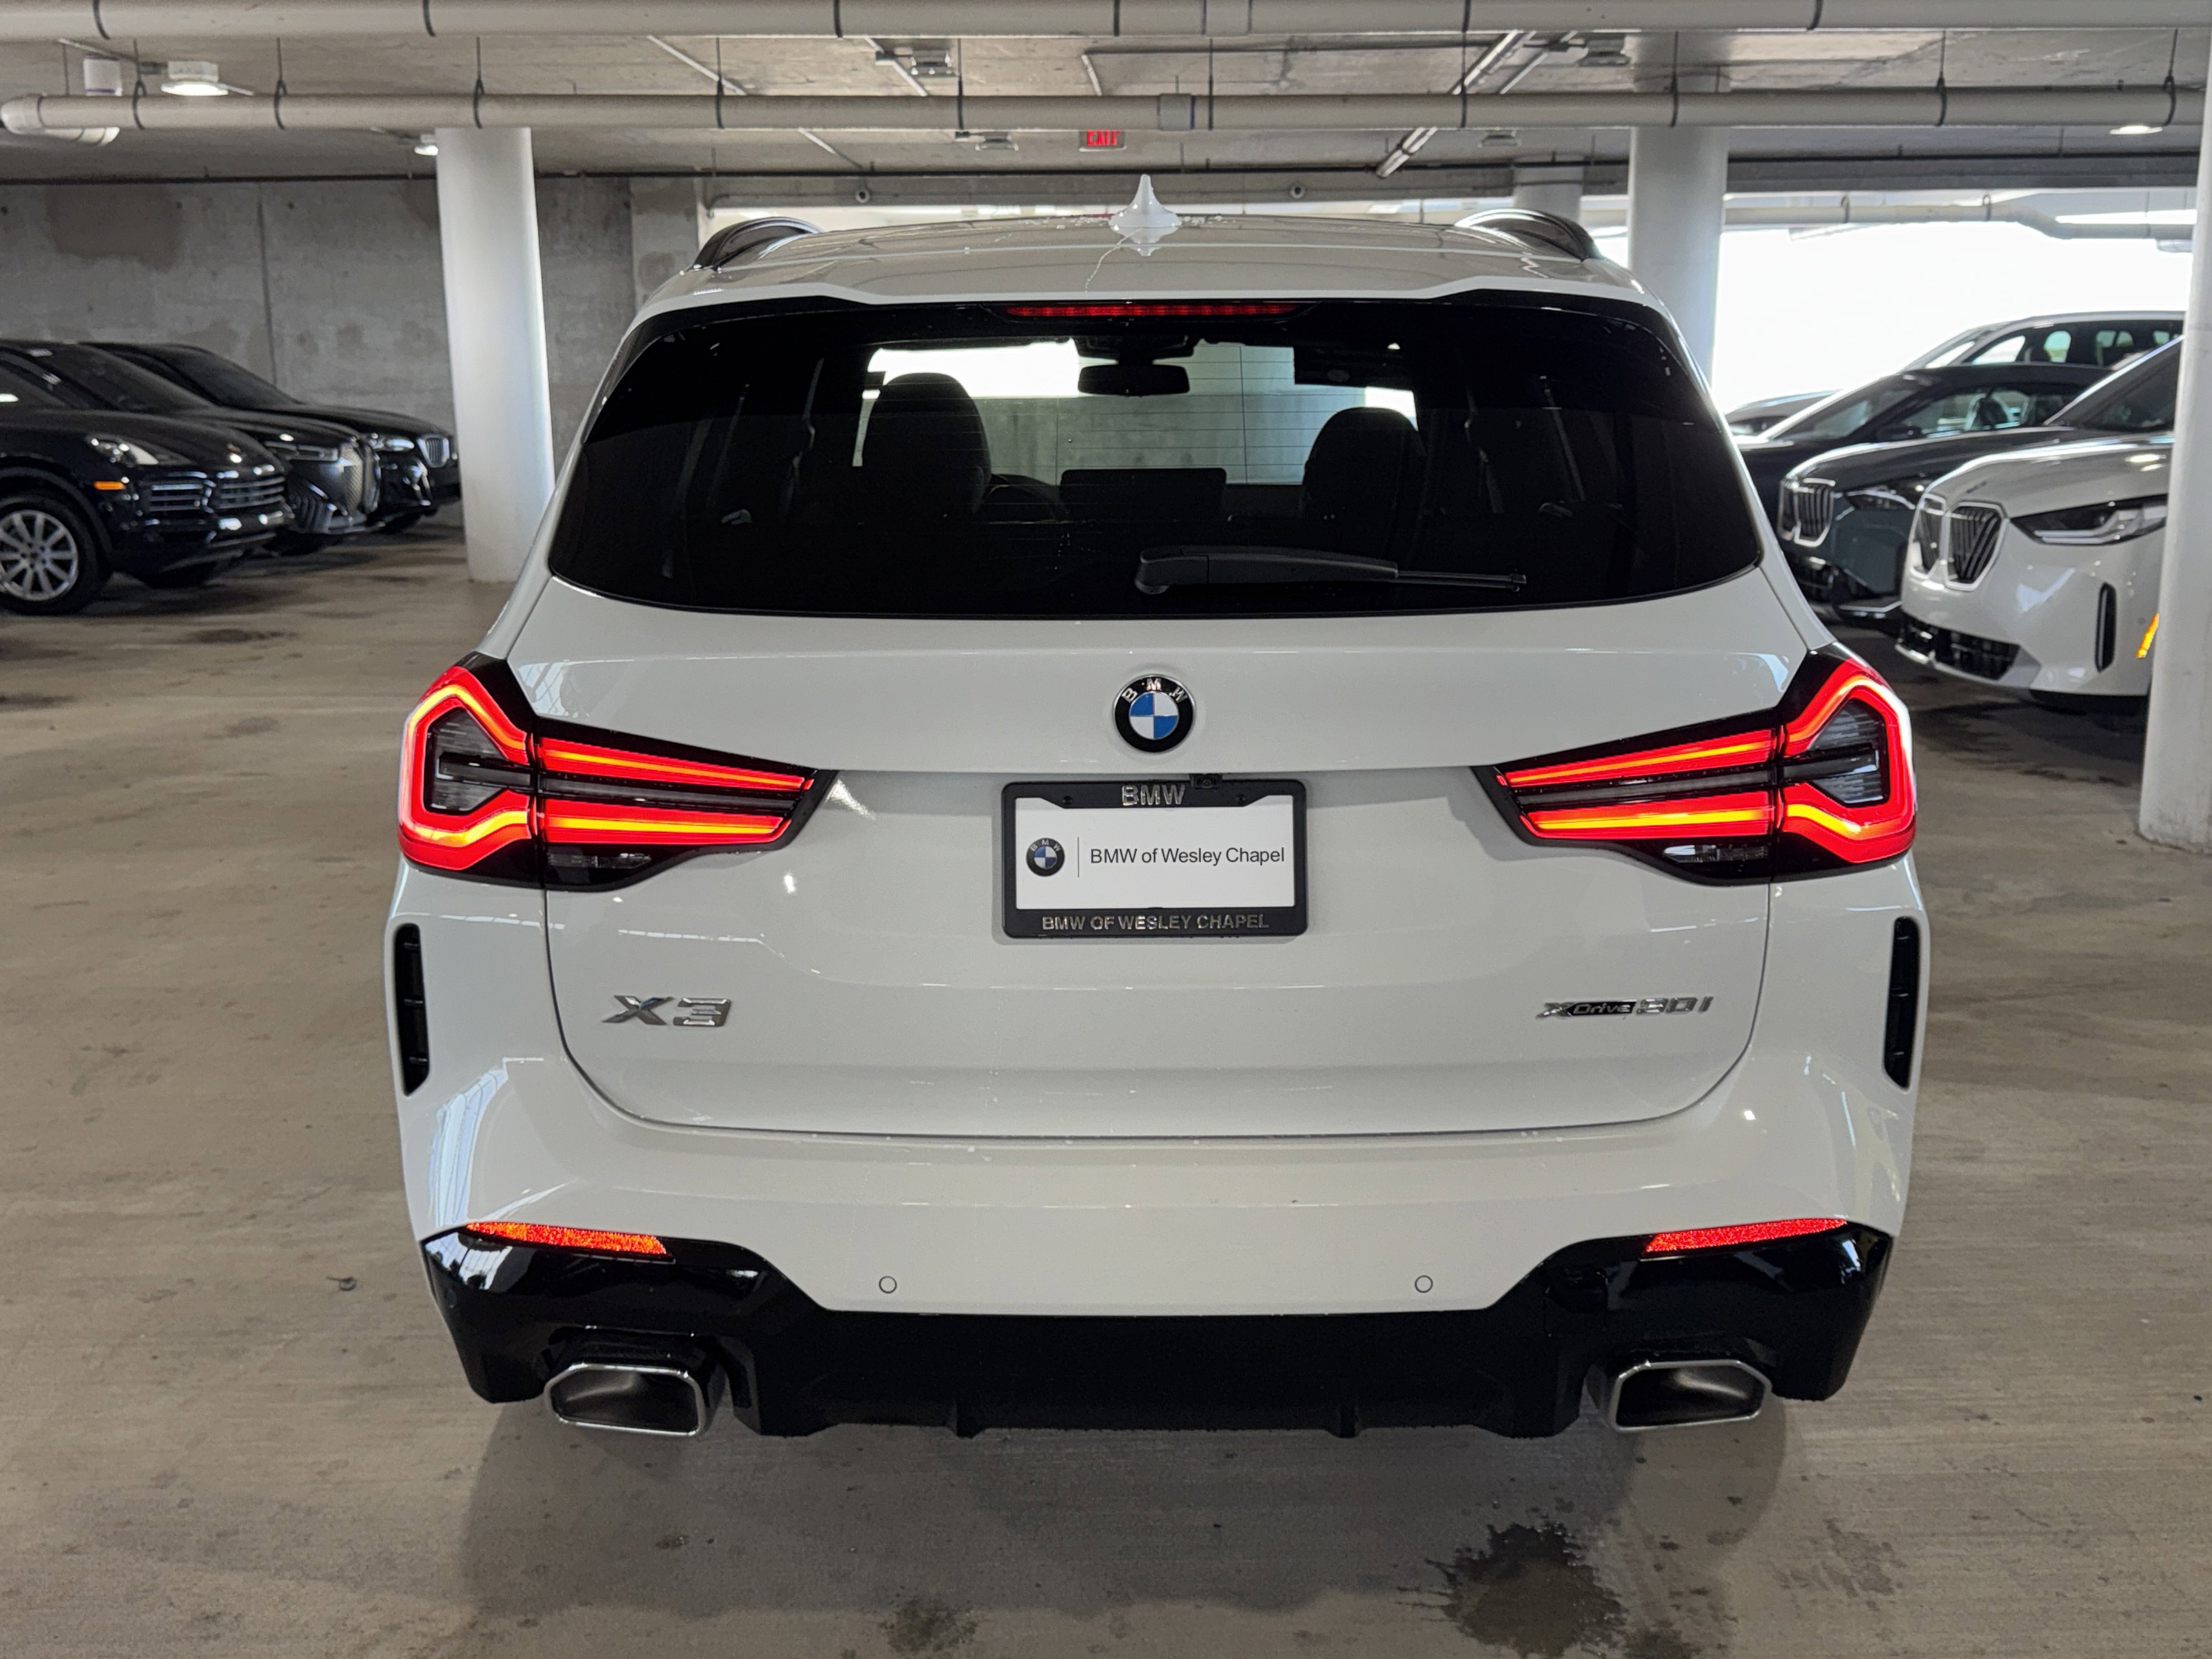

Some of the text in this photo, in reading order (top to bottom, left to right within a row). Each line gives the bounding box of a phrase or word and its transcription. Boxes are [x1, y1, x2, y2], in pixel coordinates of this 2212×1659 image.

[1122, 678, 1187, 703] BMW
[1121, 784, 1186, 806] BMW
[1031, 839, 1062, 852] BMW
[1090, 847, 1285, 867] BMW of Wesley Chapel
[1042, 913, 1269, 930] BMW OF WESLEY CHAPEL
[601, 995, 731, 1027] X3
